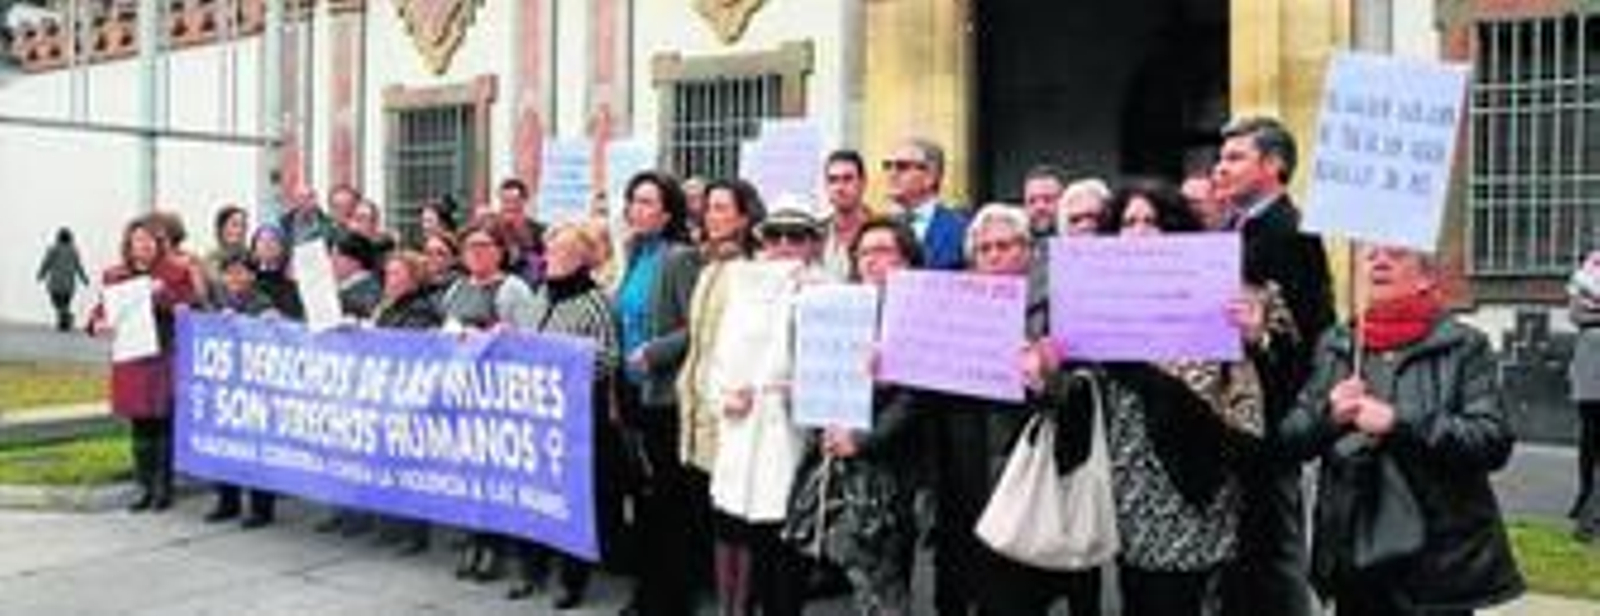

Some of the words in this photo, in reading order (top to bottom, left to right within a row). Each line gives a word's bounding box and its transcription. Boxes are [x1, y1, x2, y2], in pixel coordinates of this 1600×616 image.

[193, 338, 233, 381] LOS
[241, 342, 349, 396] DERECHOS
[358, 357, 391, 402] DE
[393, 359, 439, 407] LAS
[442, 361, 563, 419] MUJERES
[216, 388, 268, 431] SON
[385, 412, 537, 472] HUMANOS
